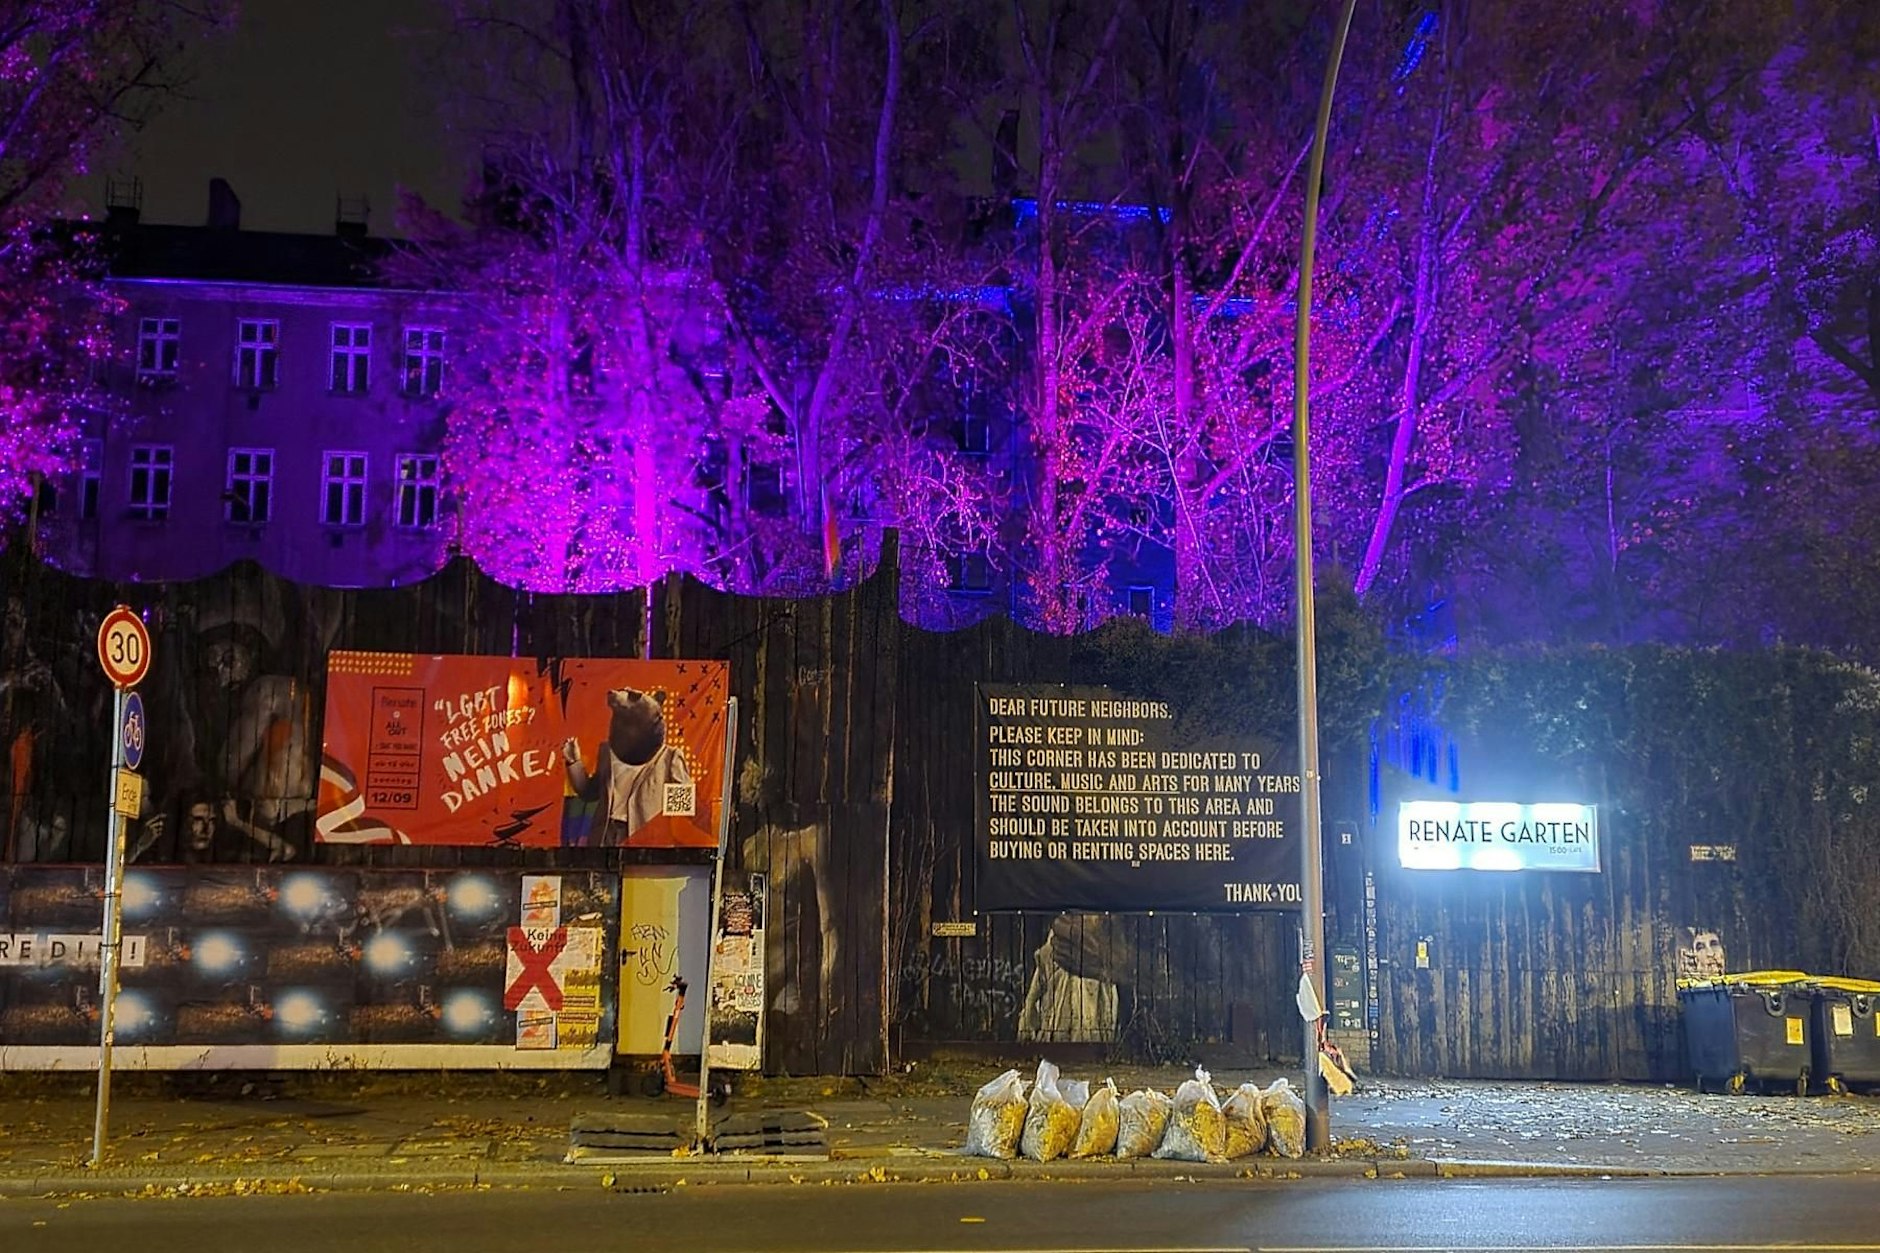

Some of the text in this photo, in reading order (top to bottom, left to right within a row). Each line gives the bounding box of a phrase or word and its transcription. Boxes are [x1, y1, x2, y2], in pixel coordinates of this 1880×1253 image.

[111, 632, 139, 665] 30
[990, 698, 1025, 716] DEAR
[1031, 699, 1086, 717] FUTURE
[440, 717, 481, 750] FREE
[990, 726, 1145, 746] PLEASE KEEP IN MIND:
[442, 731, 511, 783] NEIN
[990, 749, 1261, 770] THIS CORNER HAS BEEN DEDICATED TO
[440, 750, 556, 814] DANKE!
[1061, 773, 1103, 790] MUSIC
[1108, 774, 1136, 791] AND
[1142, 774, 1178, 791] ARTS
[1183, 775, 1210, 792] FOR
[1215, 775, 1252, 793] MANY
[371, 791, 412, 803] 12/09
[990, 794, 1274, 816] THE SOUND BELONGS TO THIS AREA AND
[990, 818, 1284, 838] SHOULD BE TAKEN INTO ACCOUNT BEFORE
[1410, 819, 1590, 844] RENATE GARTEN
[990, 841, 1235, 862] BUYING OR RENTING SPACES HERE.
[1224, 883, 1272, 902] THANK
